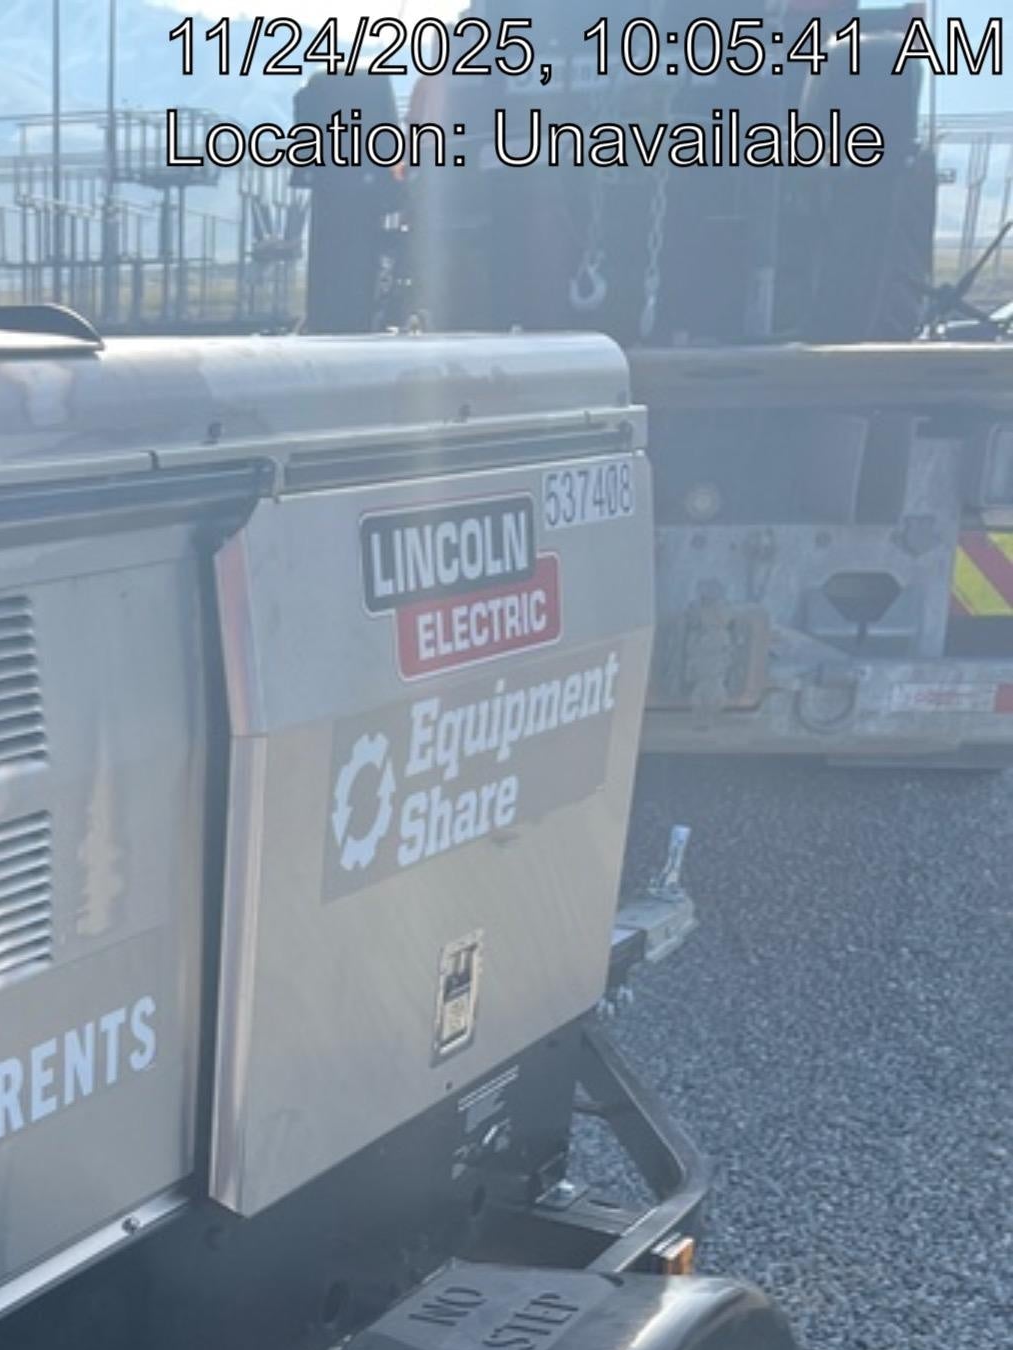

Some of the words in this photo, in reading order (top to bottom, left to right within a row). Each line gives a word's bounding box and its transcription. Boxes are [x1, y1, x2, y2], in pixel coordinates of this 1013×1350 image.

[545, 464, 633, 527] 537408
[370, 511, 530, 598] LINCOLN
[416, 589, 548, 661] ELECTRIC
[405, 651, 621, 781] Equipment
[397, 774, 519, 868] Share
[408, 1286, 484, 1327] NO
